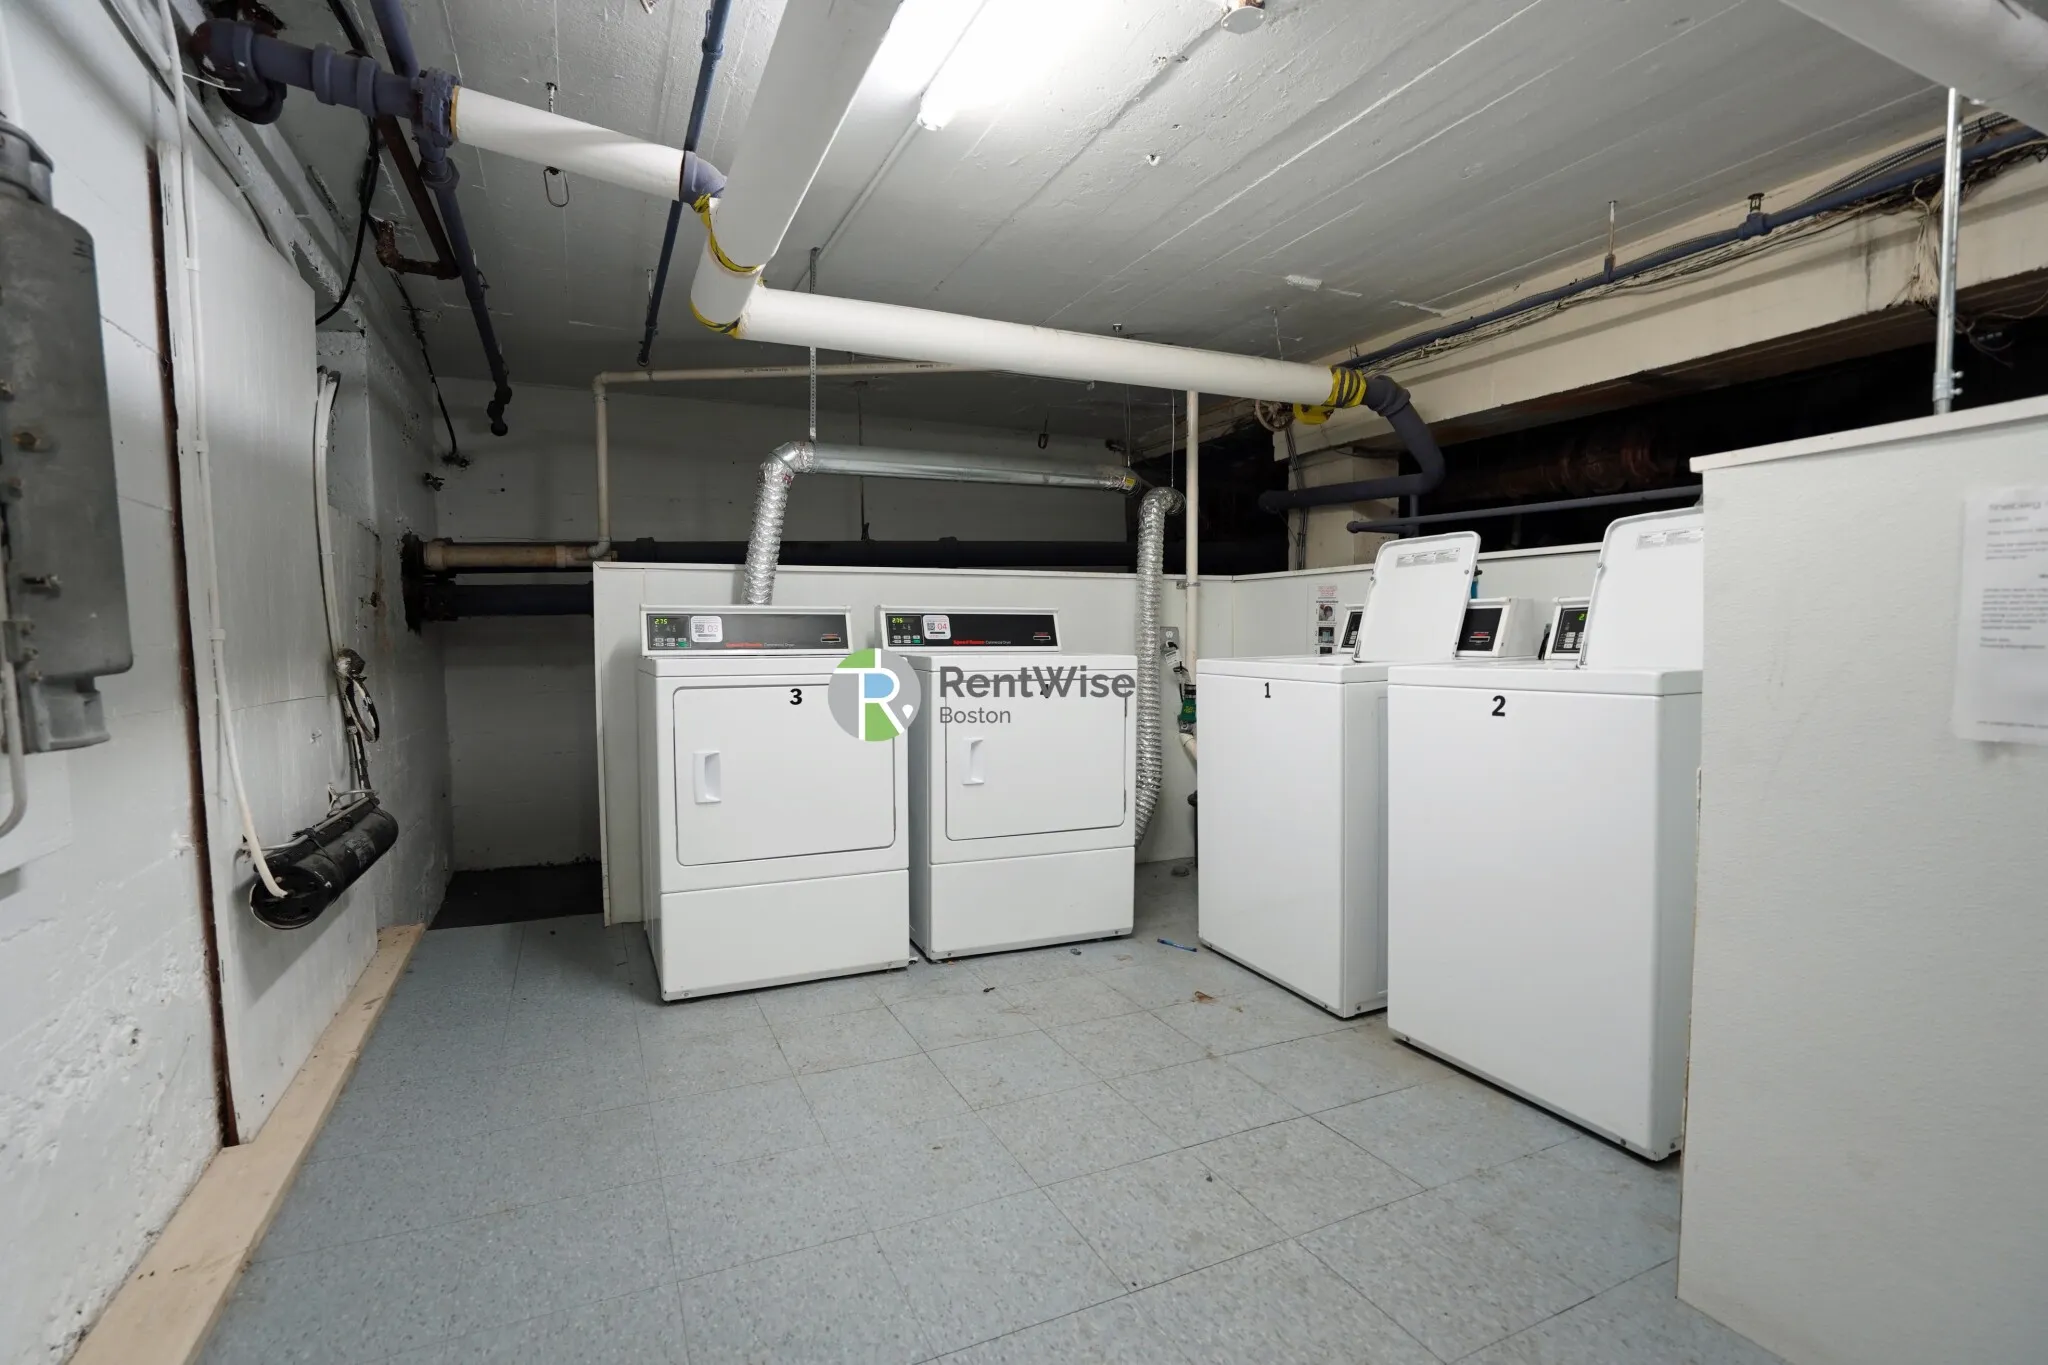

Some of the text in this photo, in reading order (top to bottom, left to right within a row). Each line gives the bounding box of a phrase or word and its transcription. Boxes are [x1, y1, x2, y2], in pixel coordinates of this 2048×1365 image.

[707, 624, 719, 633] 03
[789, 688, 803, 706] 3
[1264, 681, 1271, 699] 1
[1491, 695, 1506, 717] 2
